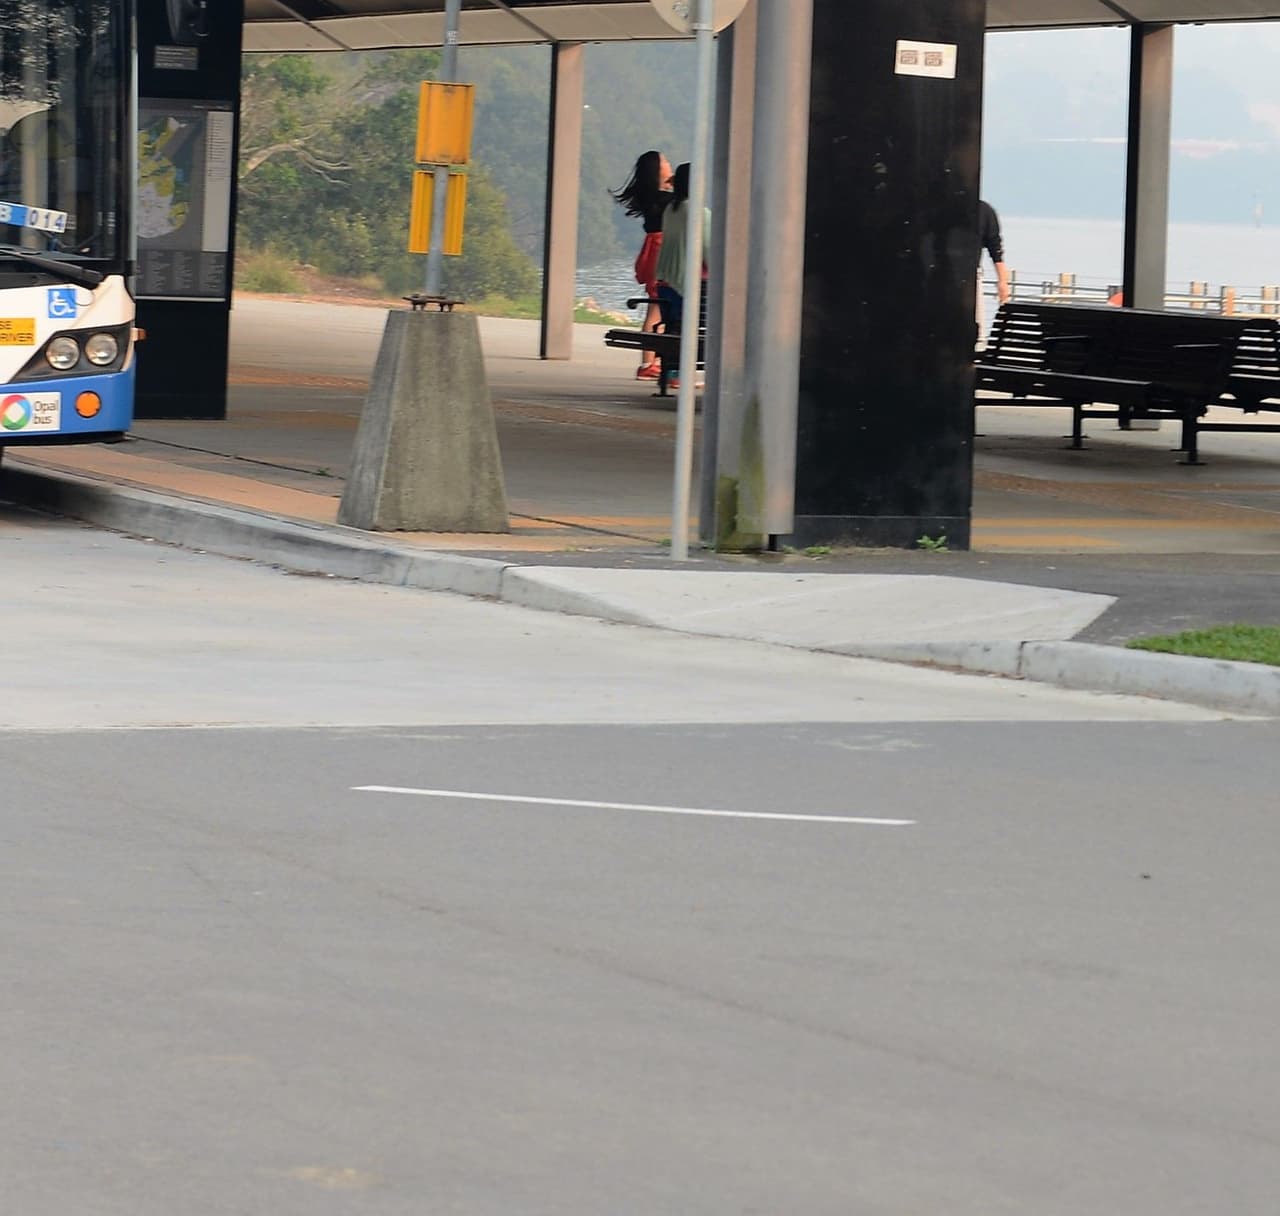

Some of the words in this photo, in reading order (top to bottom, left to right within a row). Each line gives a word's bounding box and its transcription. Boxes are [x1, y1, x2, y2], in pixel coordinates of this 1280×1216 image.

[30, 209, 65, 230] 014
[34, 400, 59, 415] Opal
[33, 414, 53, 424] bus
